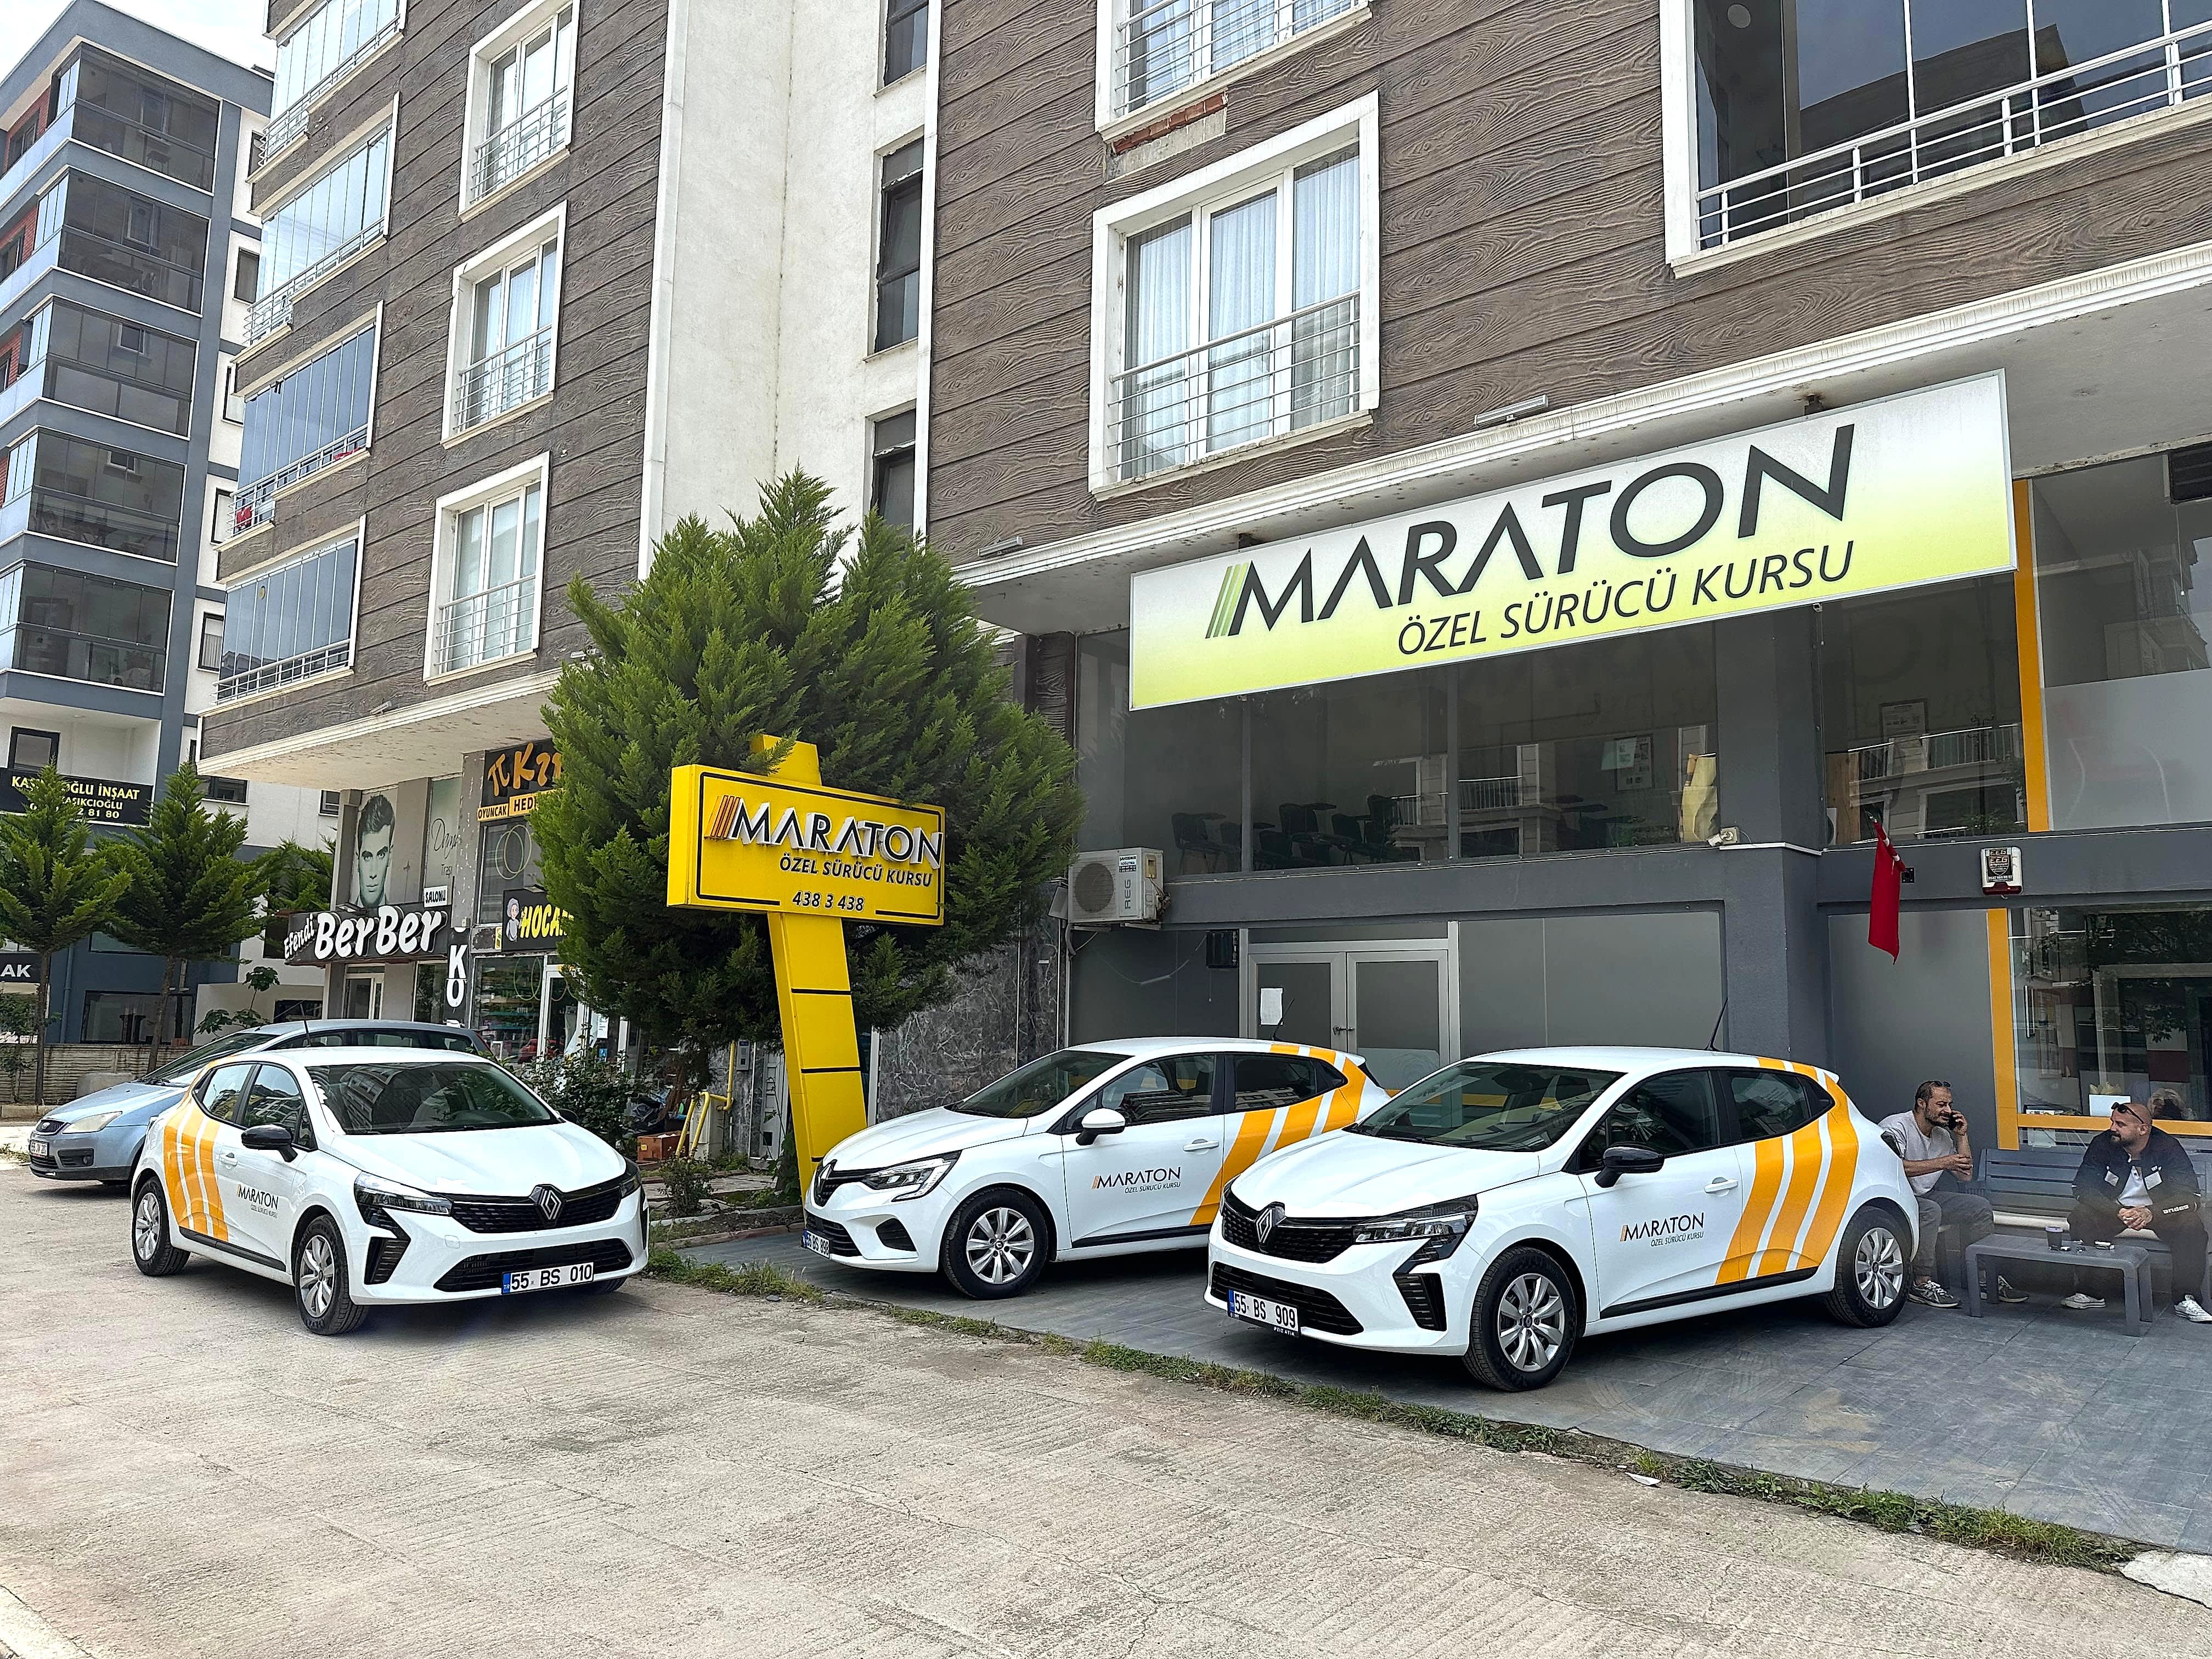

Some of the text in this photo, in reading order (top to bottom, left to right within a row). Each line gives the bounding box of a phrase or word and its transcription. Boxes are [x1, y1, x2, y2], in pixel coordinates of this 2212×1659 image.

[1228, 424, 1855, 636] MARATON
[1398, 540, 1854, 656] ÖZEL SÜRÜCÜ KURSU
[98, 783, 140, 800] İNŞAAT
[88, 809, 100, 817] 81
[105, 810, 120, 819] 80
[478, 805, 507, 819] OYUNCAK
[731, 799, 944, 869] MARATON
[780, 853, 933, 887] ÖZEL SÜRÜCÜ KURSU
[793, 891, 865, 911] 438 3 438
[284, 913, 314, 959] Efendi
[425, 889, 445, 904] SALONU
[1097, 1166, 1181, 1188] MARATON
[238, 1185, 279, 1210] MARATON
[1624, 1212, 1703, 1241] MARATON
[511, 1264, 592, 1289] 55 BS 010
[1234, 1293, 1295, 1328] 55 BS 909
